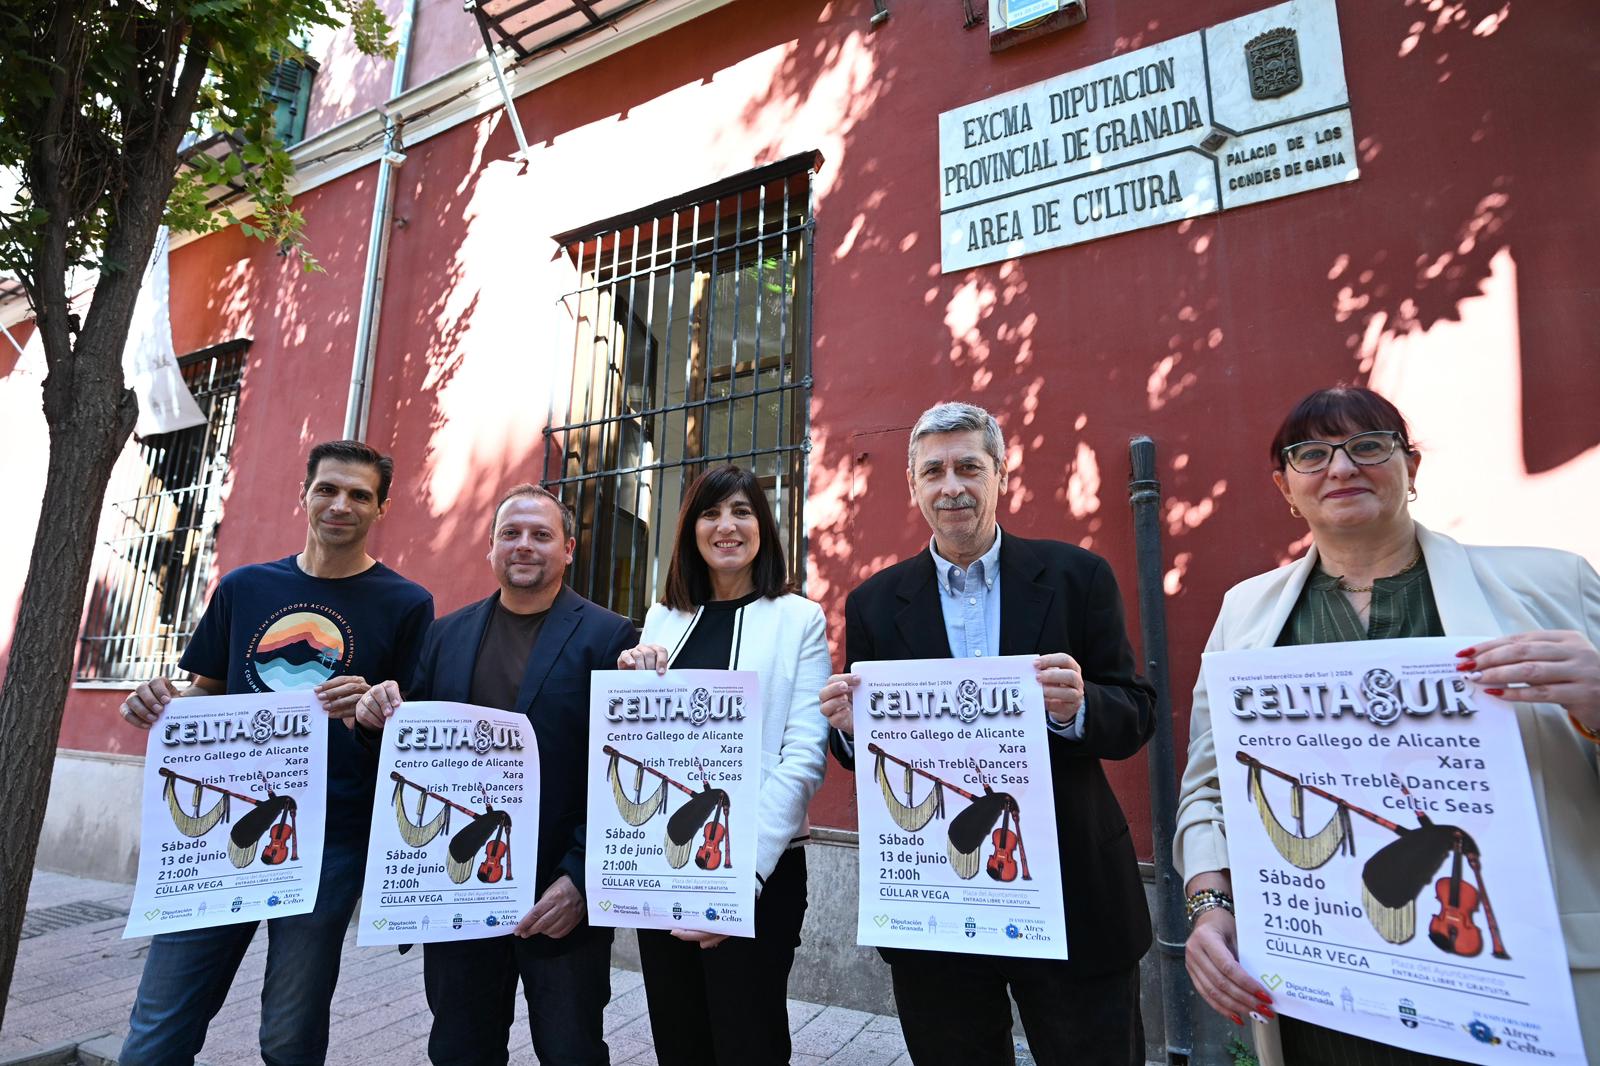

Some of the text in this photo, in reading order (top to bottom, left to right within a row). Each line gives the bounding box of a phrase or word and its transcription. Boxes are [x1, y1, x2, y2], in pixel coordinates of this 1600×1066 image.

[963, 57, 1175, 149] EXCMA DIPUTACION
[944, 96, 1203, 196] PROVINCIAL DE GRANADA
[1226, 126, 1342, 166] PALACIO DE LOS
[1229, 151, 1346, 190] CONDES DE GABIA
[967, 170, 1183, 252] AREA DE CULTURA
[270, 603, 308, 620] OUTDOORS
[310, 603, 347, 625] ACCESSIBLE
[345, 625, 352, 634] TO
[246, 633, 259, 658] MAKING
[345, 635, 355, 668] EVERYONE
[867, 679, 1026, 723] CELTASUR
[1230, 668, 1479, 727] CELTASUR
[605, 688, 747, 726] CELTASUR
[161, 710, 312, 746] CELTASUR
[871, 728, 1025, 742] Centro Gallego de Alicante
[394, 720, 526, 755] CELTASUR
[607, 731, 744, 742] Centro Gallego de Alicante
[1238, 734, 1480, 750] Centro Gallego de Alicante
[163, 745, 309, 764] Centro Gallego de Alicante
[720, 745, 743, 754] Xara
[999, 744, 1026, 753] Xara
[285, 757, 309, 766] Xara
[394, 758, 524, 769] Centro Gallego de Alicante
[643, 758, 665, 767] Irish
[702, 758, 743, 767] Dancers
[911, 759, 935, 769] Irish
[980, 759, 1028, 769] Dancers
[1437, 755, 1485, 770] Xara
[202, 775, 225, 785] Irish
[266, 769, 308, 779] Dancers
[502, 771, 524, 779] Xara
[687, 772, 742, 781] Celtic Seas
[964, 774, 1029, 784] Celtic Seas
[1300, 772, 1336, 786] Irish
[1407, 776, 1490, 792] Dancers
[250, 780, 308, 792] Celtic Seas
[426, 784, 448, 792] Irish
[486, 783, 523, 792] Dancers
[470, 795, 523, 804] Celtic Seas
[1382, 795, 1494, 815] Celtic Seas
[605, 828, 646, 839] Sábado
[879, 834, 924, 846] Sábado
[161, 839, 207, 852] Sábado
[605, 844, 663, 857] 13 de junio
[161, 851, 227, 866] 13 de junio
[386, 849, 427, 860] Sábado
[880, 851, 948, 865] 13 de junio
[385, 864, 445, 876] 13 de junio
[603, 860, 637, 871] 21:00h
[158, 868, 198, 880] 21:00h
[880, 868, 920, 880] 21:00h
[1259, 868, 1326, 890] Sábado
[155, 880, 223, 895] CÚLLAR VEGA
[382, 880, 420, 890] 21:00h
[602, 876, 661, 888] CÚLLAR VEGA
[381, 894, 443, 904] CÚLLAR VEGA
[880, 885, 950, 900] CÚLLAR VEGA
[1262, 892, 1363, 919] 13 de junio
[1264, 913, 1323, 936] 21:00h
[1266, 936, 1370, 969] CÚLLAR VEGA
[1285, 981, 1331, 997] Diputación
[1298, 992, 1334, 1006] Granada
